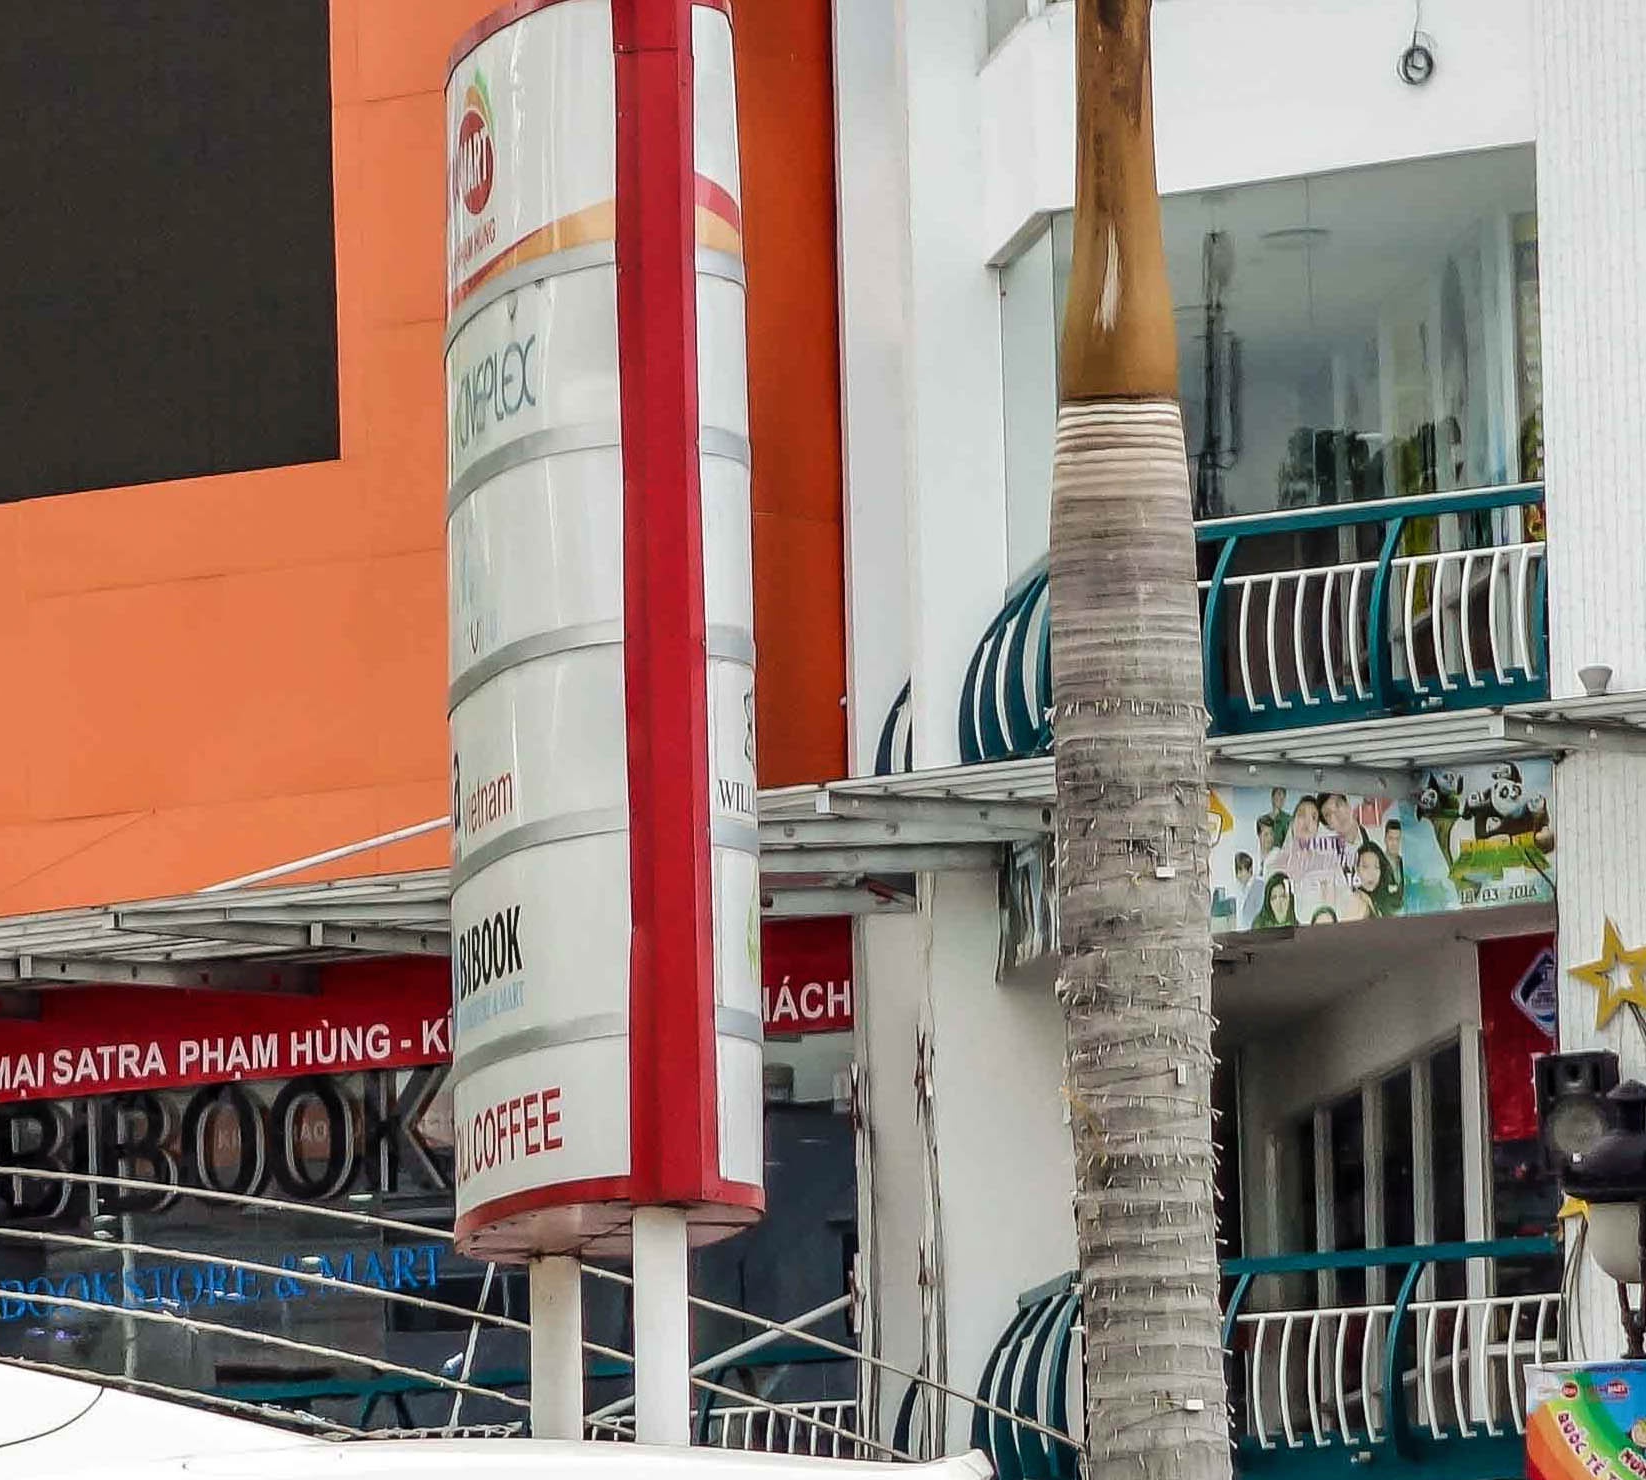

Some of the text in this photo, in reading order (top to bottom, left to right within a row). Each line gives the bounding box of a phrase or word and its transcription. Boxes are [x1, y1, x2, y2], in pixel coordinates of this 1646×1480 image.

[459, 905, 523, 1002] BIBOOK
[52, 1042, 168, 1085] SATRA
[179, 1033, 279, 1081] PHẠM
[290, 1019, 391, 1066] HÙNG
[474, 1087, 563, 1174] COFFEE
[318, 1245, 447, 1293] MART
